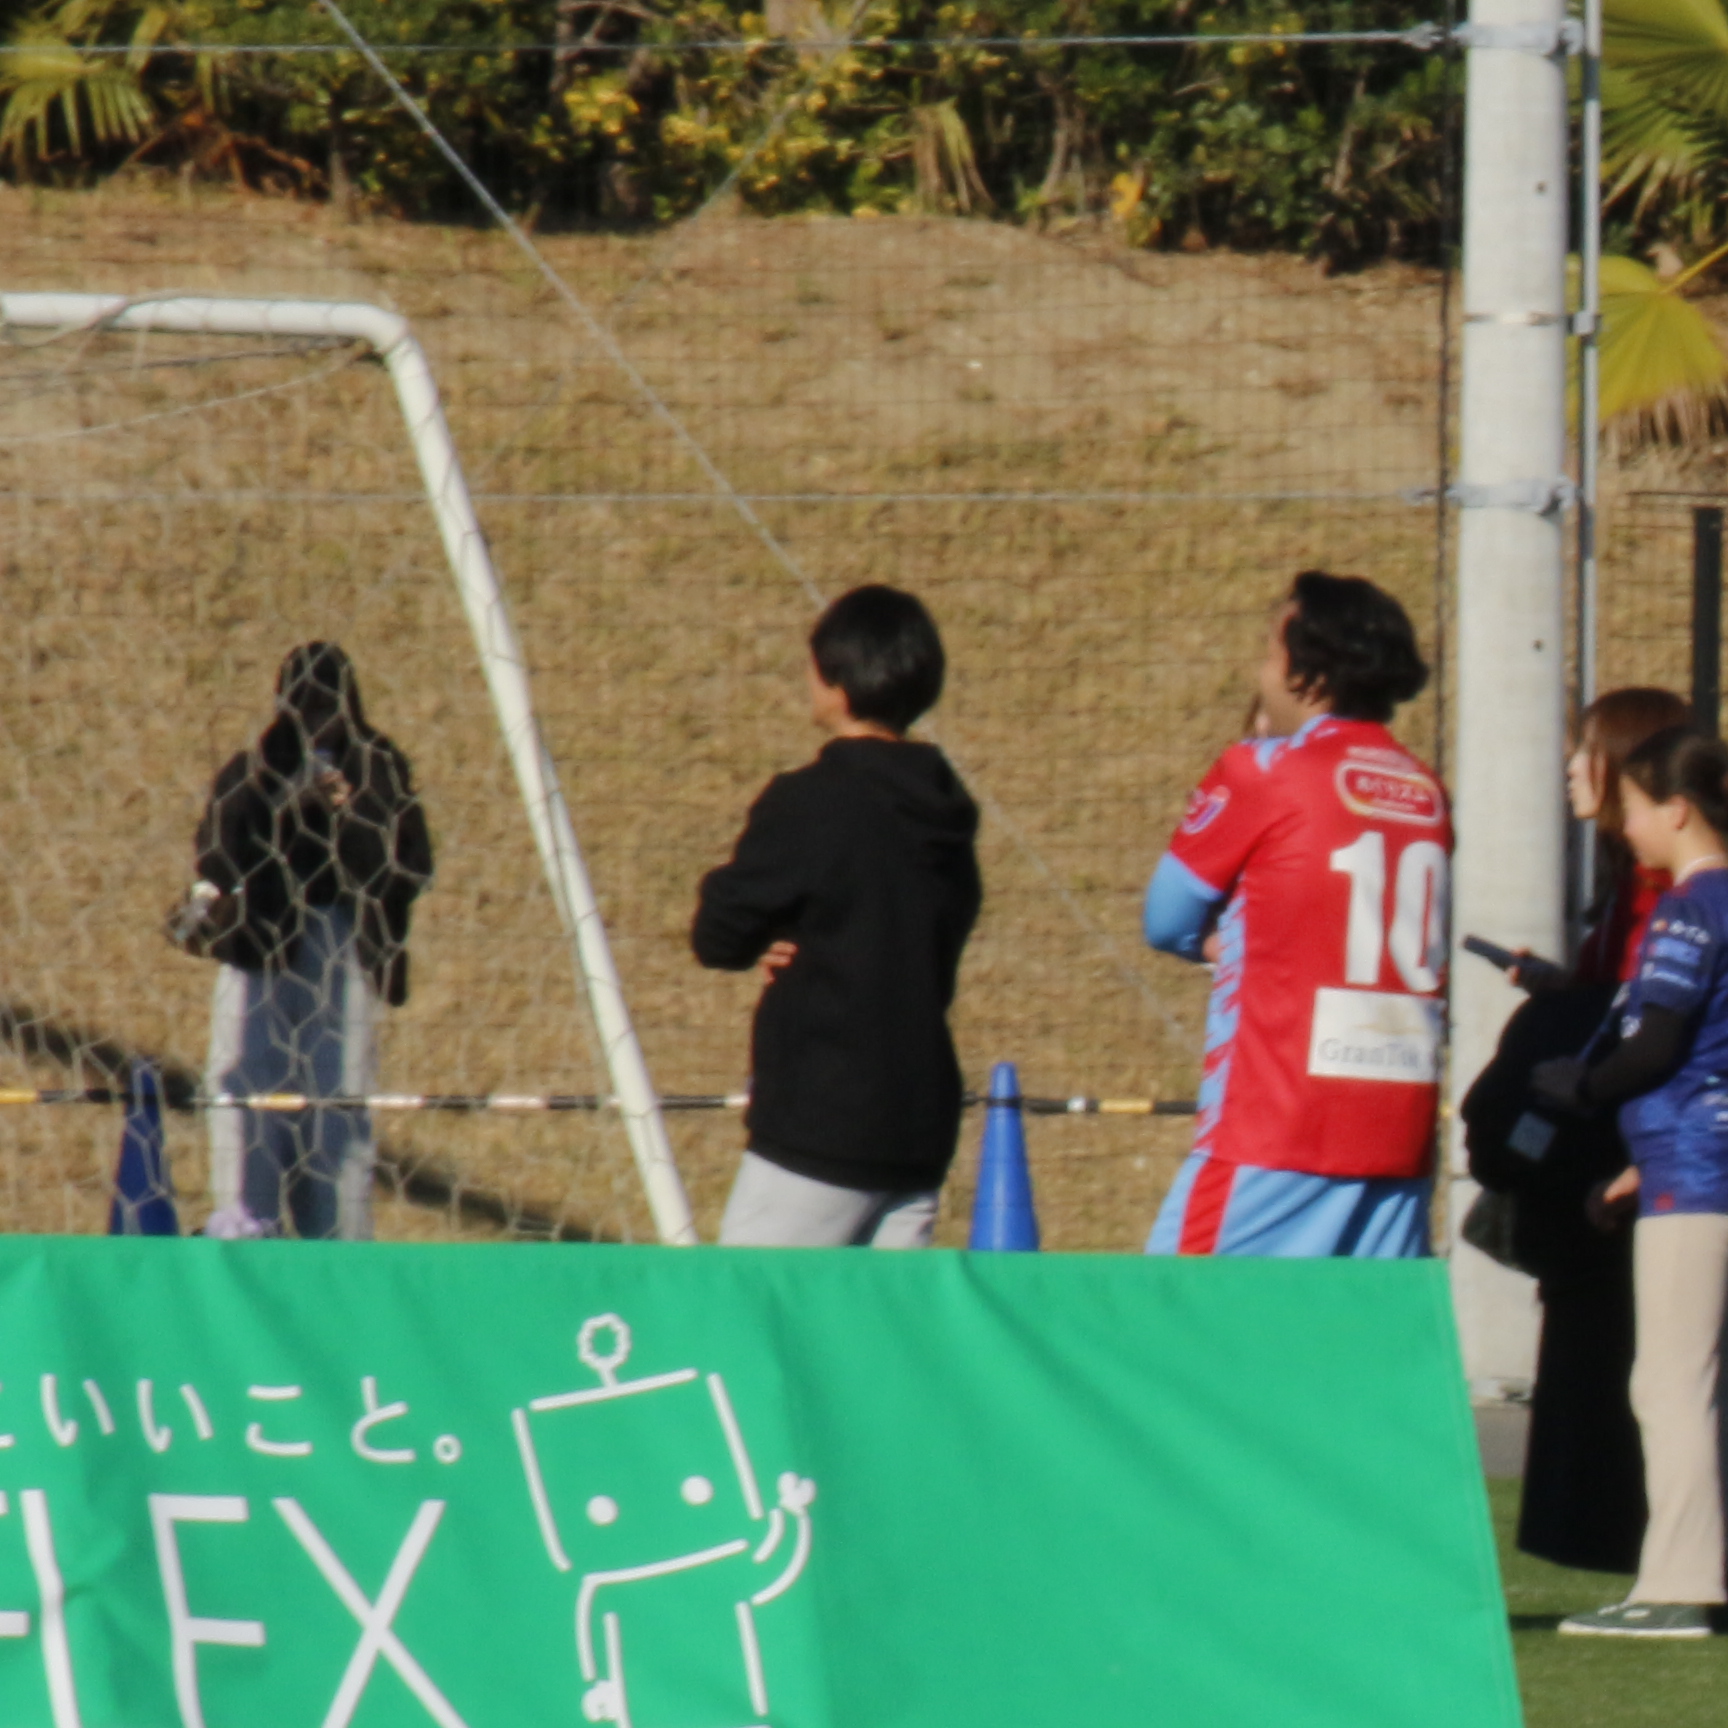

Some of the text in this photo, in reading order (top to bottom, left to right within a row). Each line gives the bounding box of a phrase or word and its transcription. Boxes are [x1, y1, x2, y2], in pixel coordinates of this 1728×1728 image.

[1328, 831, 1447, 993] 10
[0, 1373, 461, 1464] いいこと。
